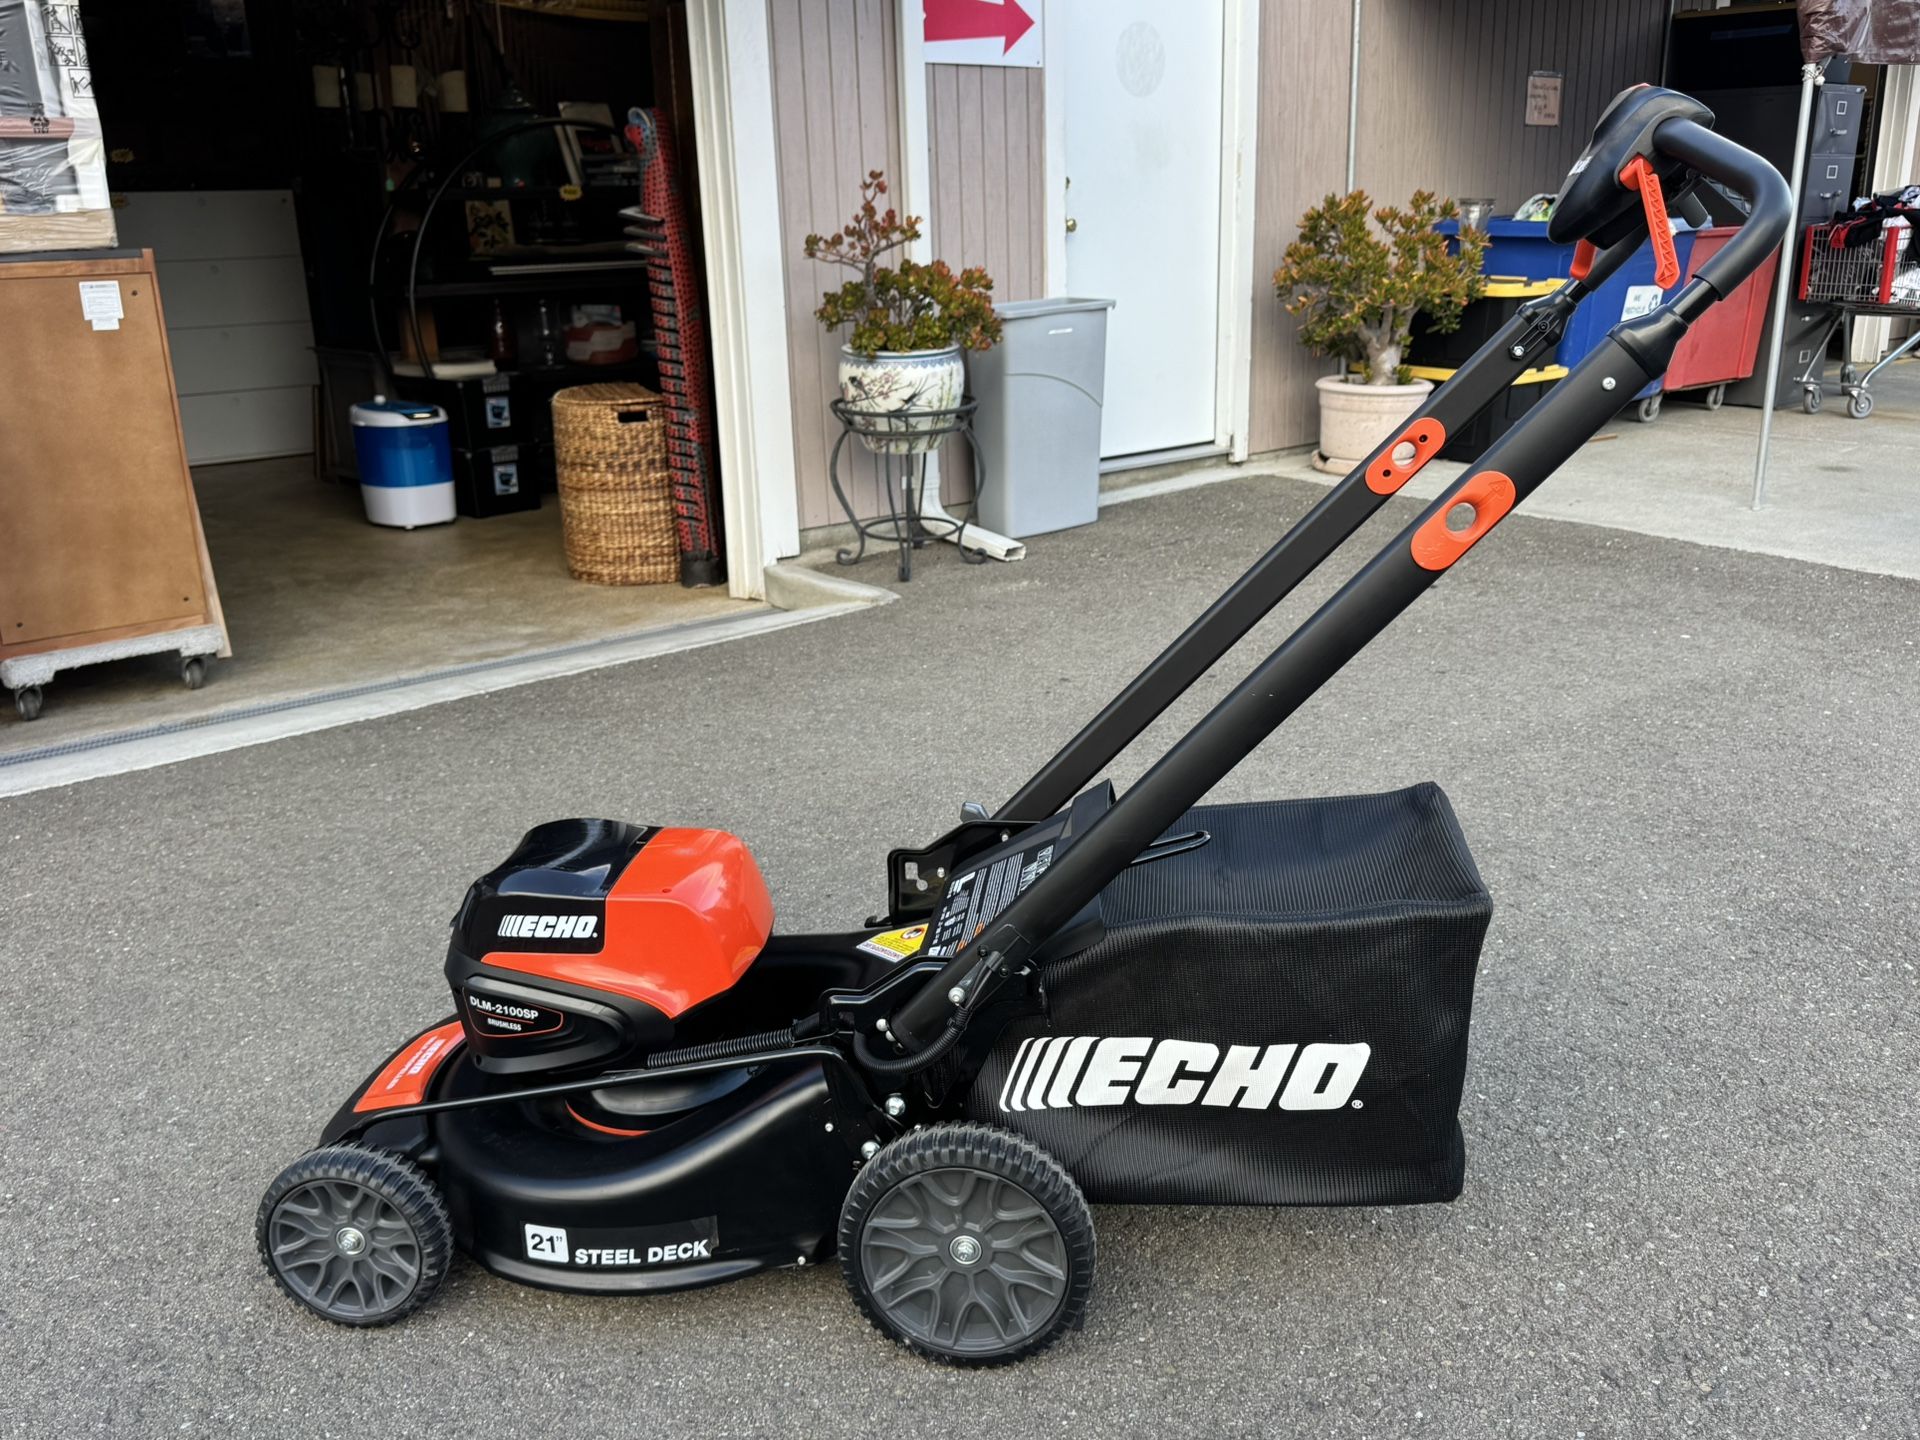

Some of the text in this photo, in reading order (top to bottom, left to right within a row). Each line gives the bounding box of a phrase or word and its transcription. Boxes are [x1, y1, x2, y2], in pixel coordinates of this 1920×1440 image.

[469, 996, 539, 1020] DLM-2100SP
[487, 1018, 522, 1032] BRUSHLESS
[530, 1233, 563, 1254] 21"
[574, 1239, 710, 1265] STEEL DECK
